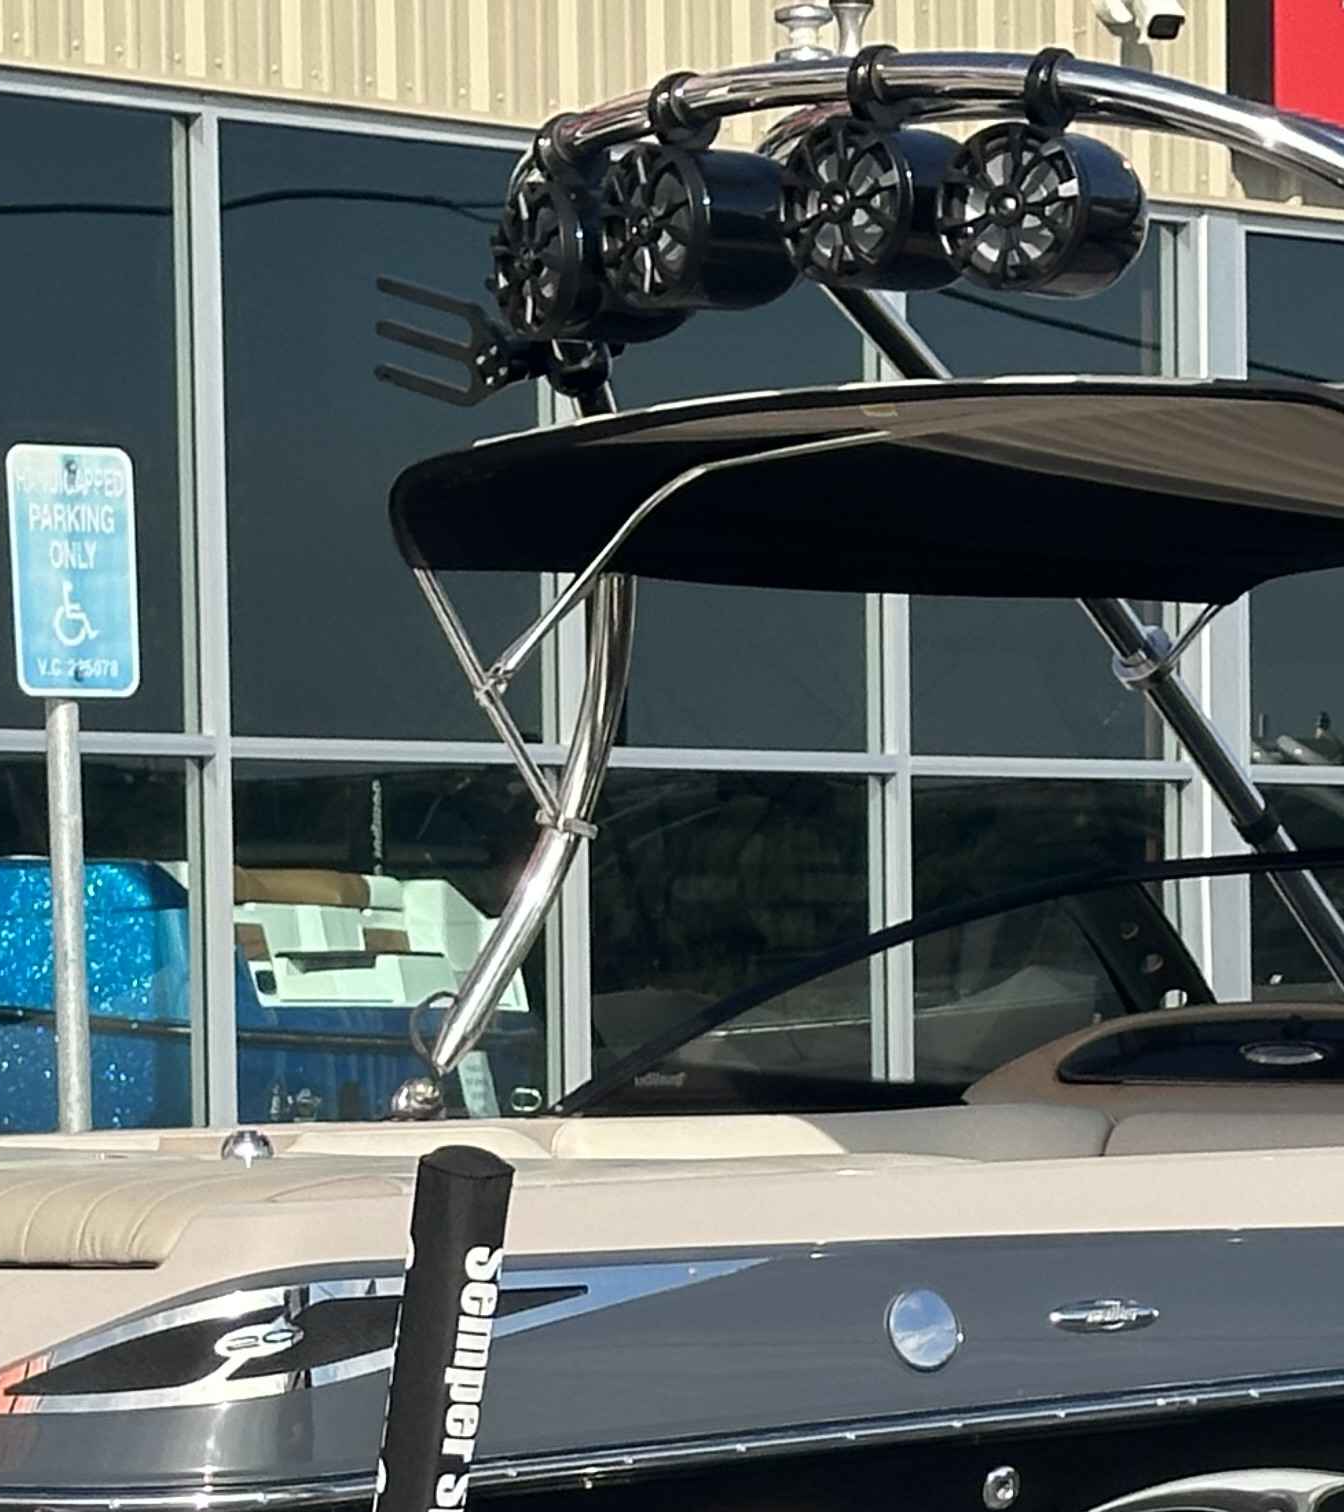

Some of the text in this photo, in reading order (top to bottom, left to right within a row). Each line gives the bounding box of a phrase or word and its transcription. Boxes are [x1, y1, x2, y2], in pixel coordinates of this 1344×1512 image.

[28, 503, 116, 533] PARKING
[48, 540, 97, 569] ONLY
[443, 1245, 503, 1460] Semper
